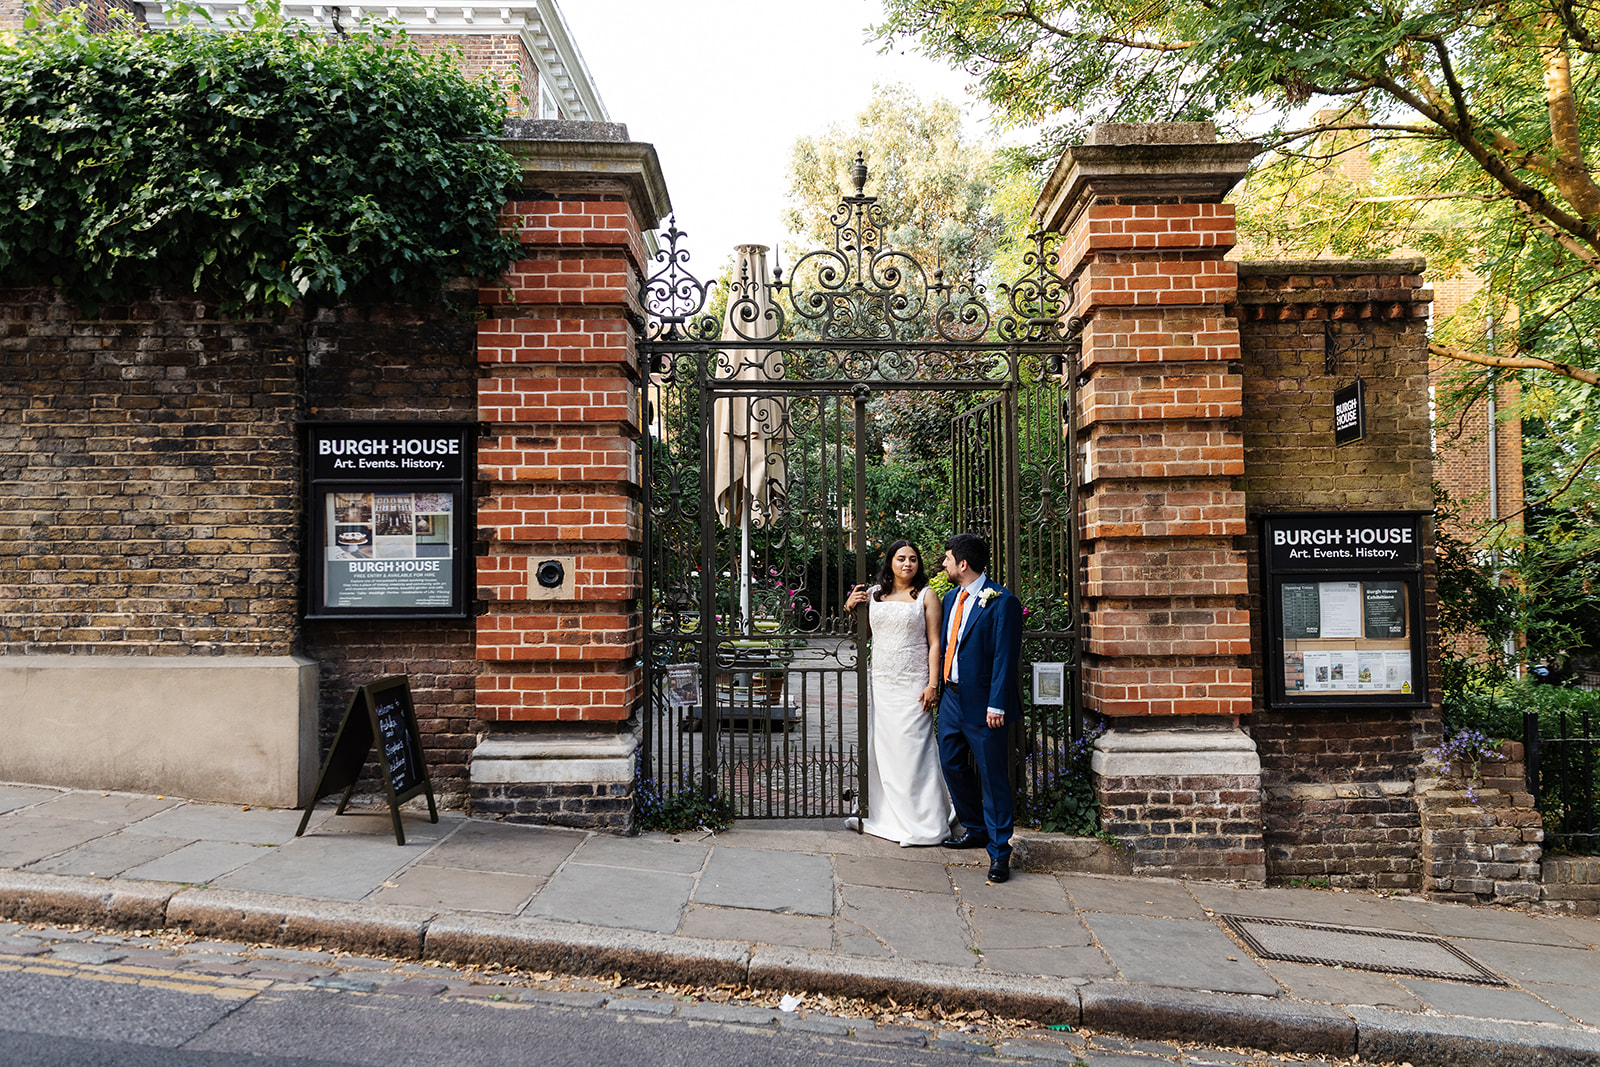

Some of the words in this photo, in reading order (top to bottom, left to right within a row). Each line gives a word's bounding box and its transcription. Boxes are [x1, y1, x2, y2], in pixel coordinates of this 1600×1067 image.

[1336, 398, 1357, 416] BURGH
[1336, 409, 1357, 426] HOUSE
[319, 439, 389, 455] BURGH
[393, 439, 459, 455] HOUSE
[334, 458, 356, 468] Art.
[358, 458, 398, 468] Events.
[402, 458, 445, 470] History.
[1274, 529, 1342, 545] BURGH
[1346, 528, 1412, 544] HOUSE
[1289, 548, 1310, 558] Art.
[1314, 548, 1353, 558] Events.
[1356, 548, 1399, 560] History.
[348, 562, 394, 572] BURGH
[396, 560, 440, 572] HOUSE
